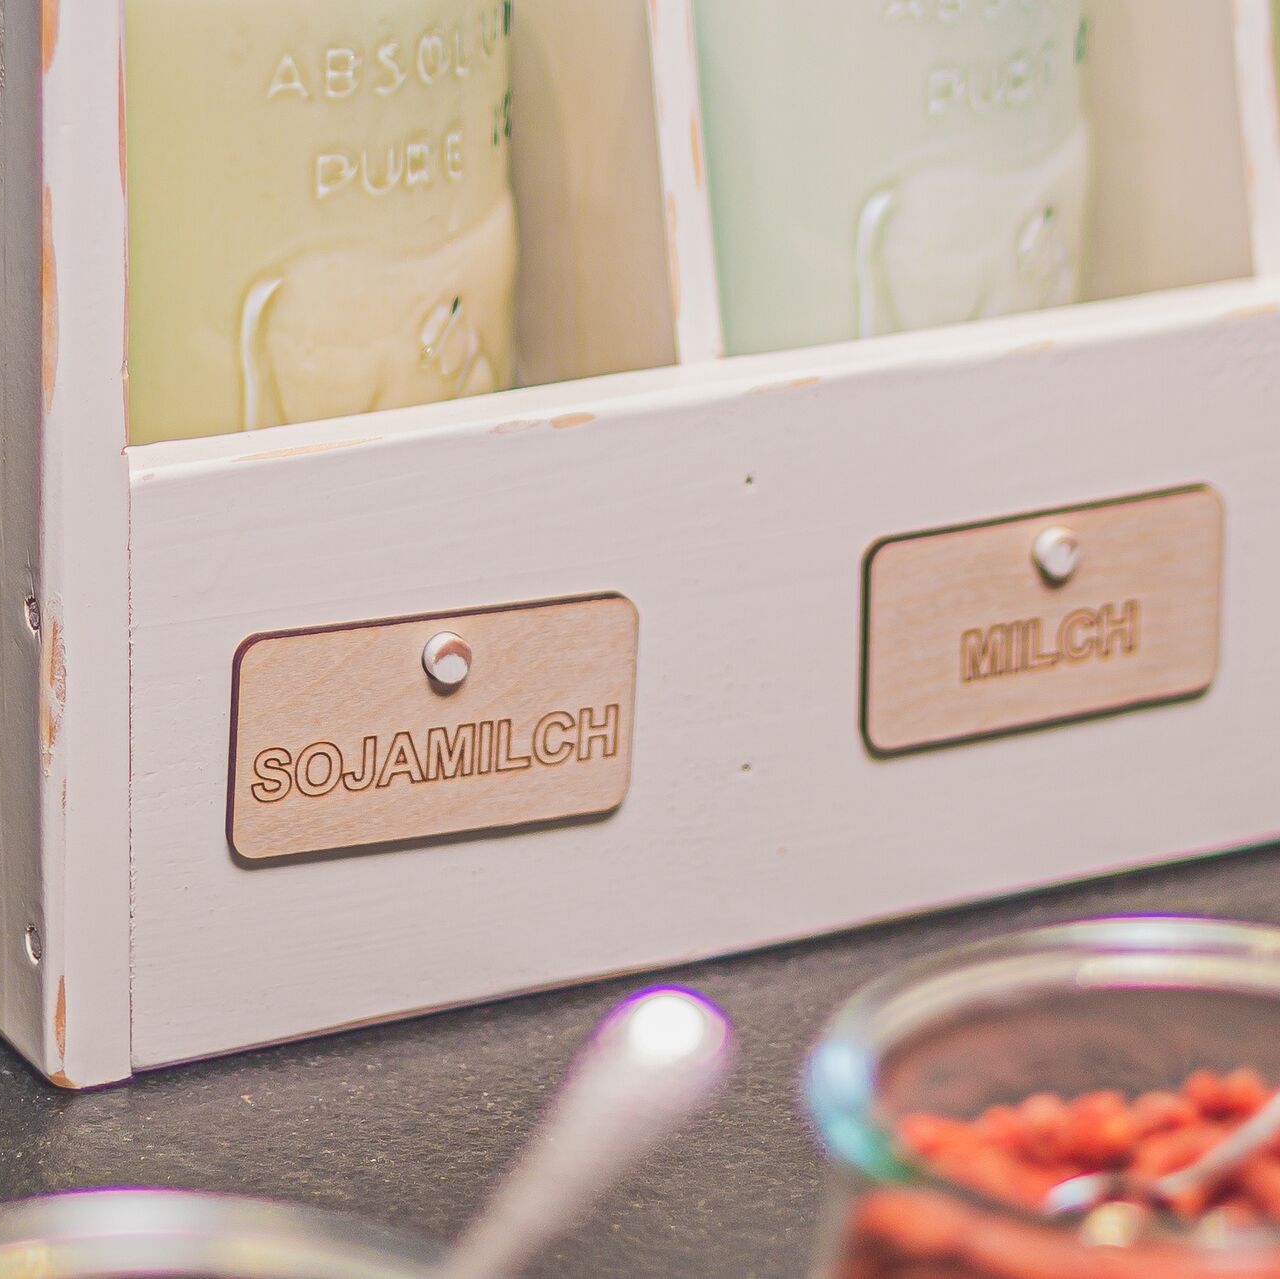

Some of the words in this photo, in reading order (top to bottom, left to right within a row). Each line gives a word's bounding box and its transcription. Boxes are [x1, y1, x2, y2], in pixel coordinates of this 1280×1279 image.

[315, 131, 465, 200] PURE
[960, 600, 1140, 684] MILCH
[250, 704, 620, 805] SOJAMILCH
